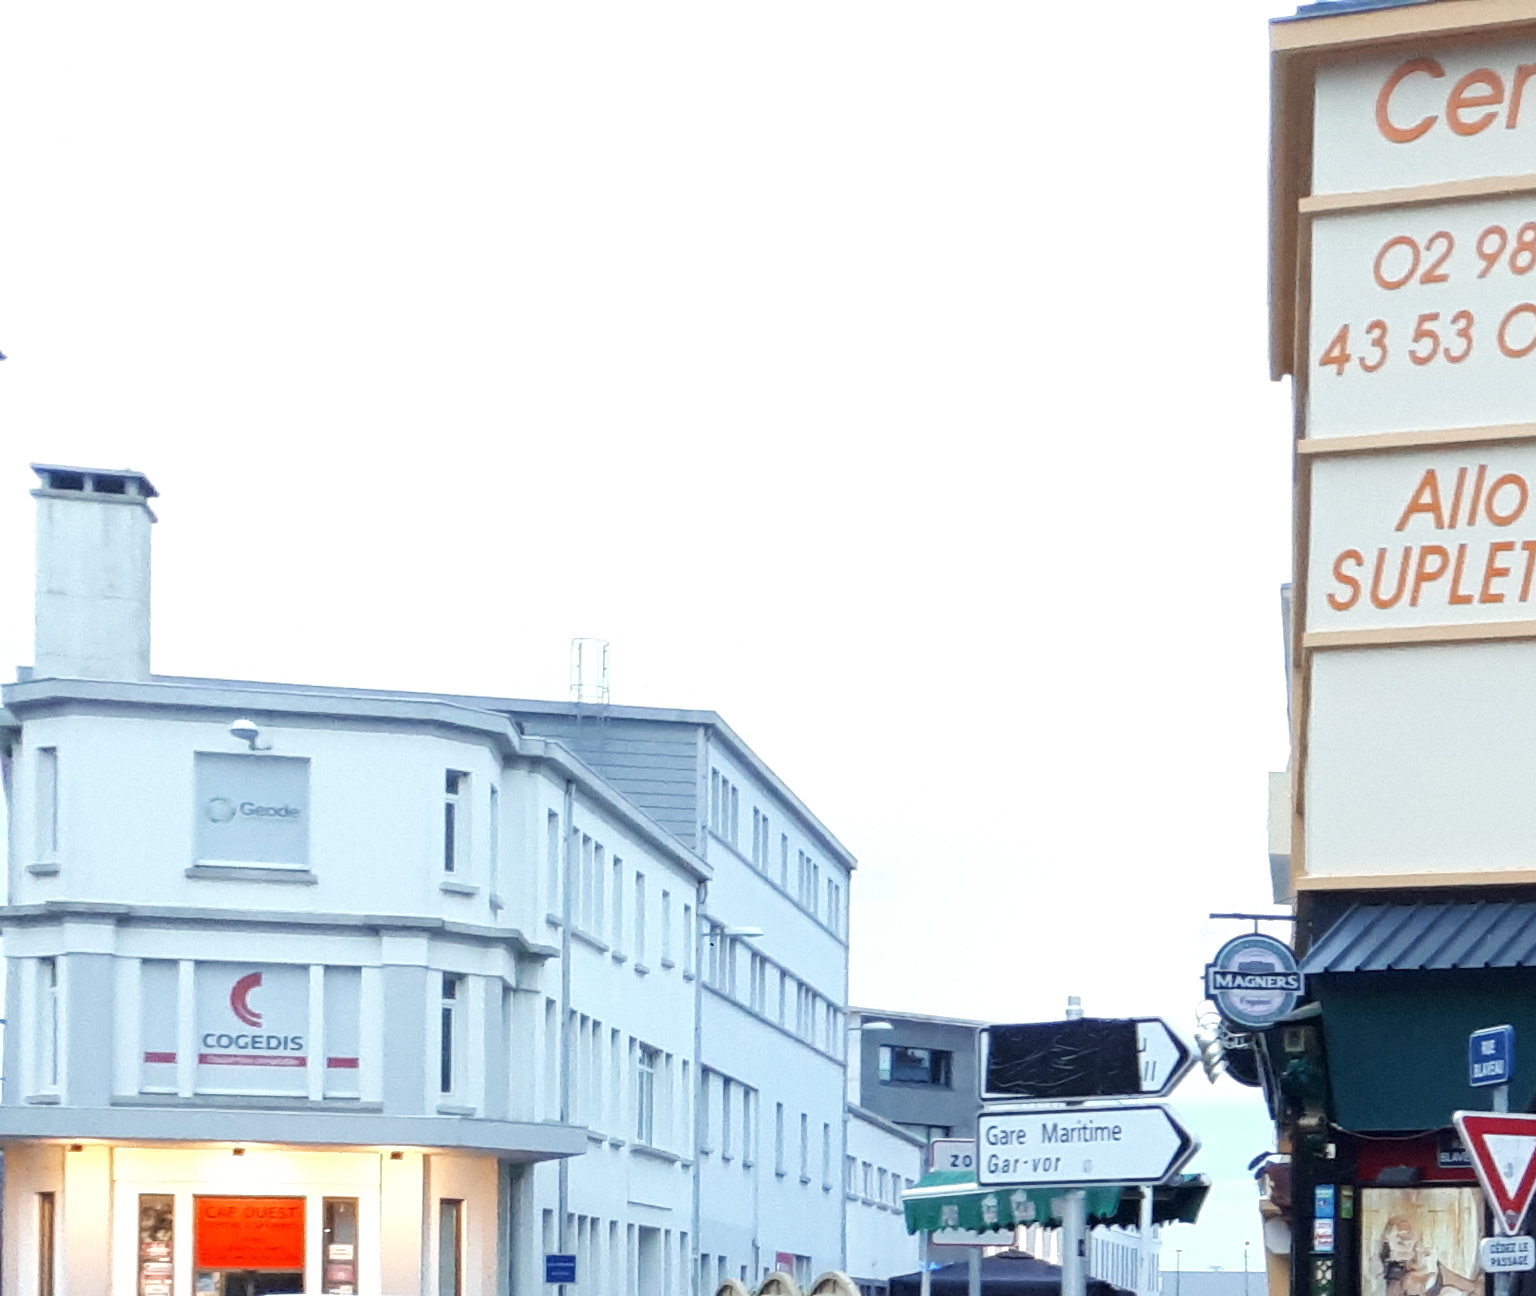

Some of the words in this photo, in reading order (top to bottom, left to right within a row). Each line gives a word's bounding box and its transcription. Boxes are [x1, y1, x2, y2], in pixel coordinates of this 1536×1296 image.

[1373, 229, 1455, 290] 02
[1319, 318, 1388, 377] 43
[1408, 310, 1474, 366] 53
[1395, 463, 1528, 533] Allo
[1214, 972, 1300, 990] MAGNERS
[202, 1032, 304, 1051] COGEDIS
[985, 1124, 1027, 1147] Gare
[1041, 1119, 1123, 1145] Maritime
[987, 1153, 1062, 1174] Gar-vor
